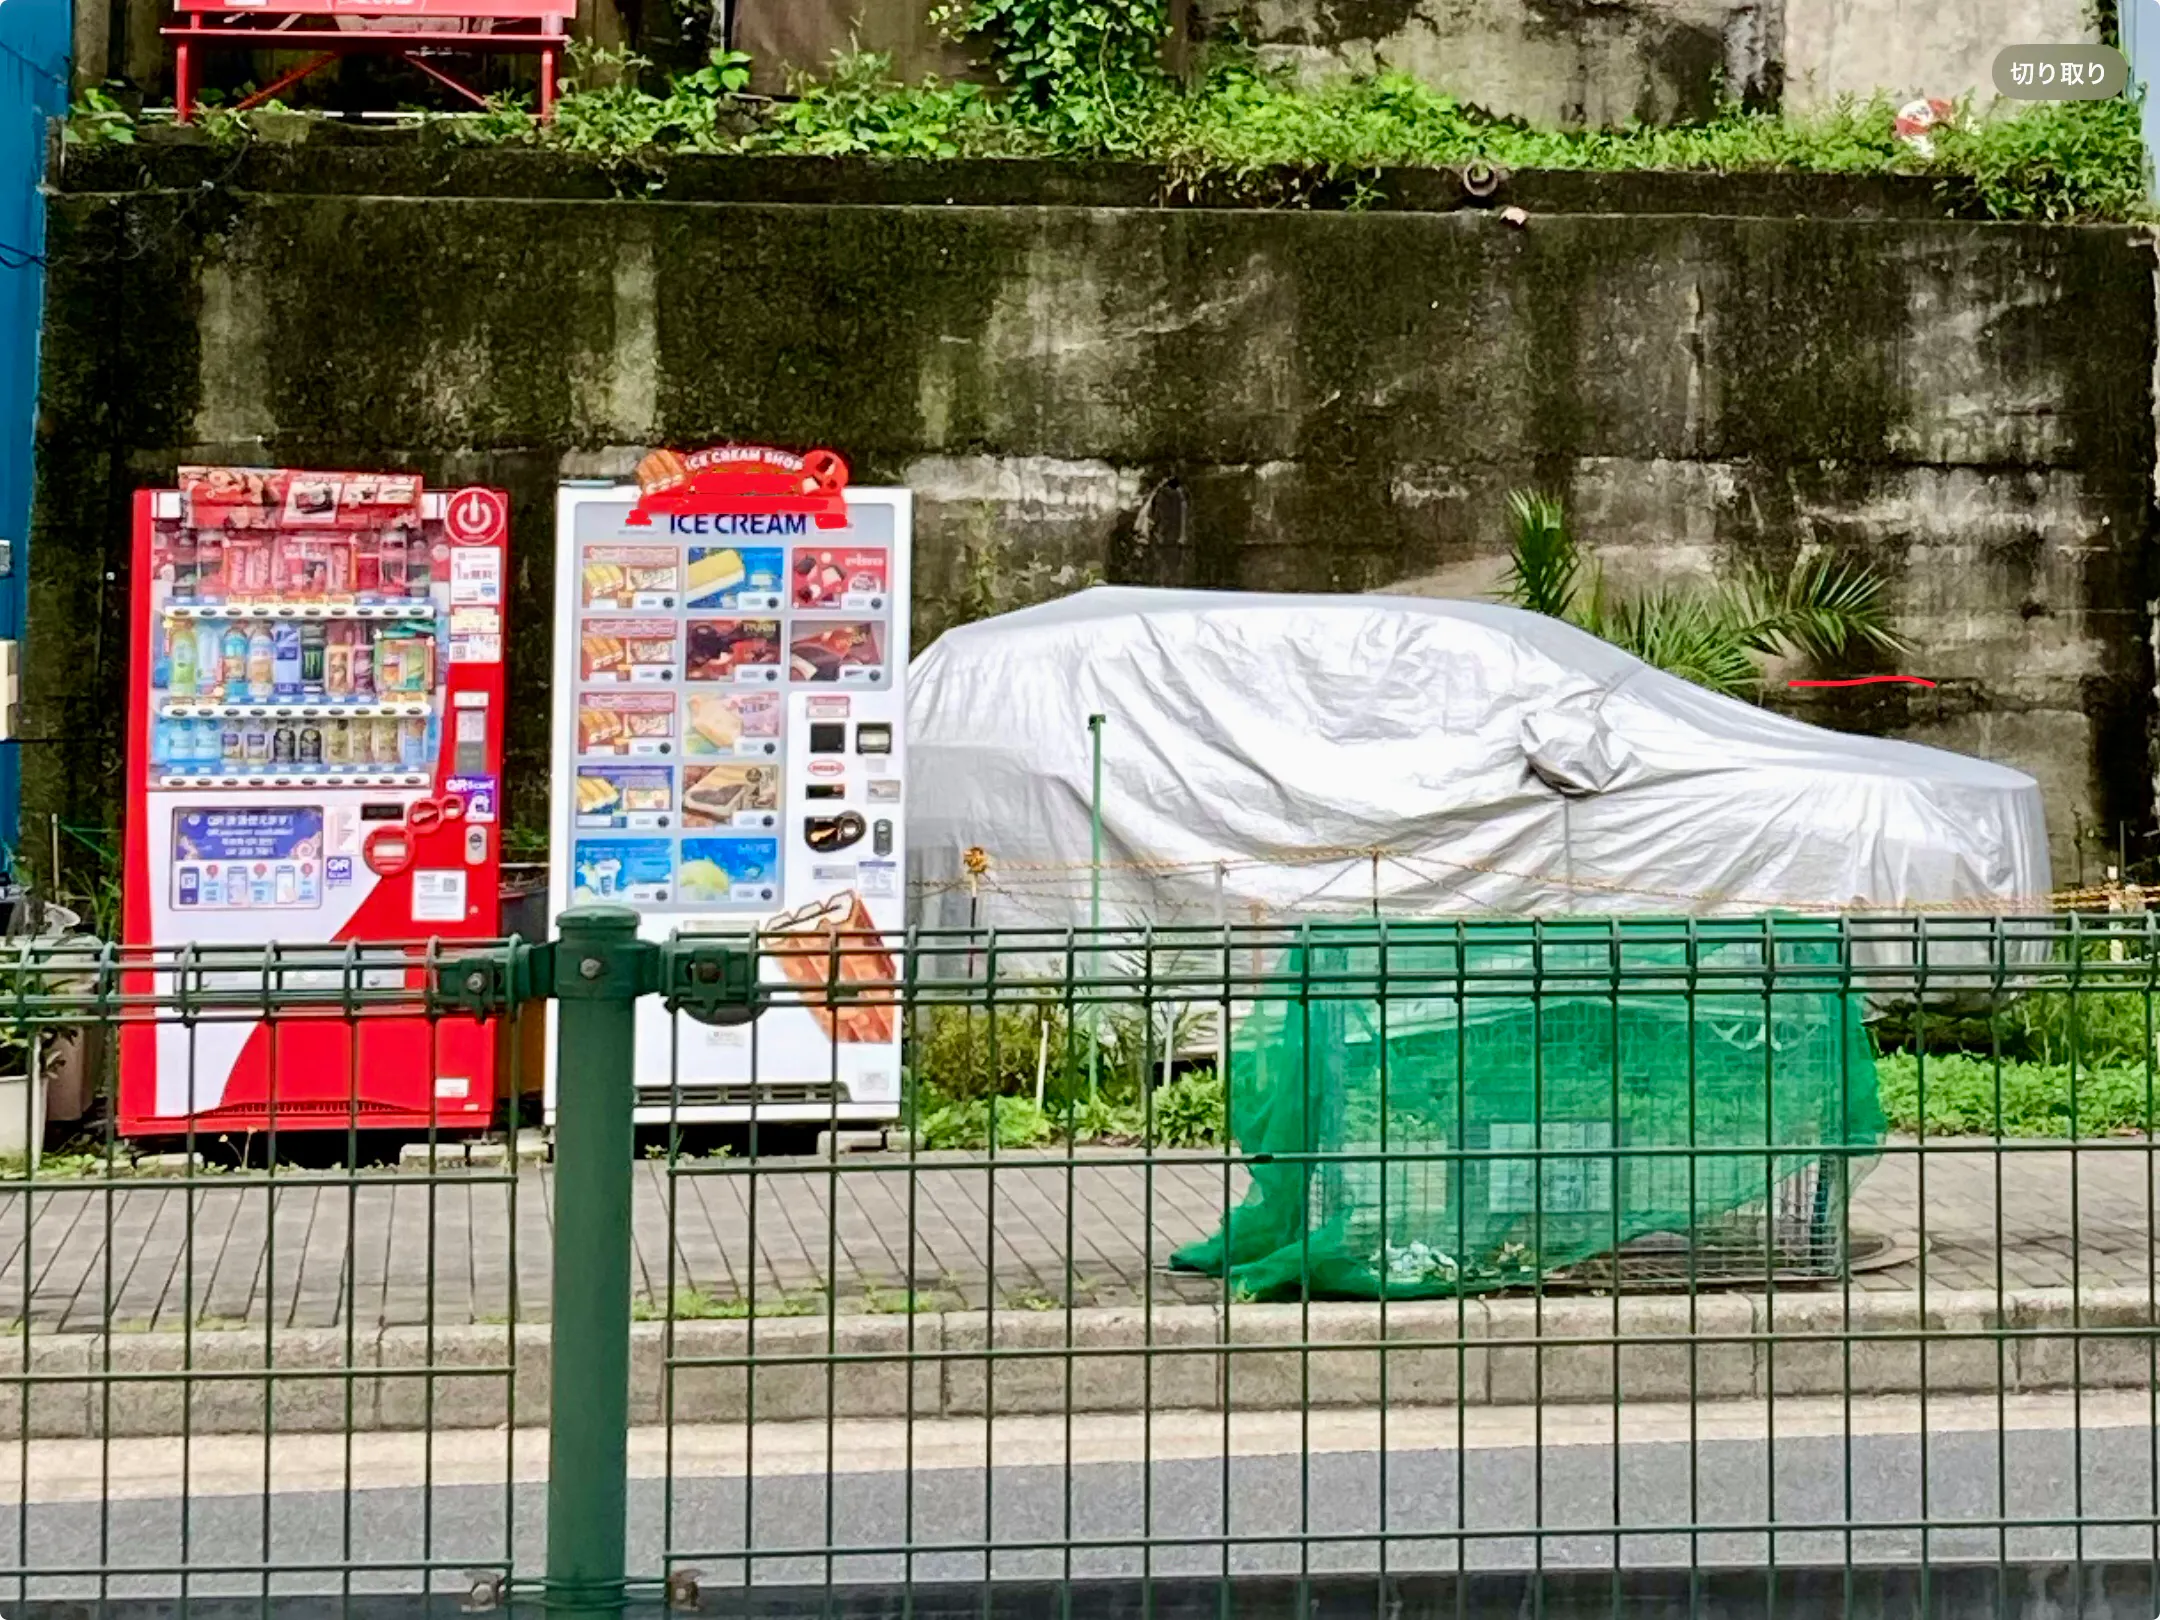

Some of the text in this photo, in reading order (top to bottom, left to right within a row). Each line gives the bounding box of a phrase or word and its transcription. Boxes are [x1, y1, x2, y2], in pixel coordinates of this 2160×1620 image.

[684, 449, 804, 472] ICE CREAM SHOP
[669, 513, 806, 534] ICE CREAM
